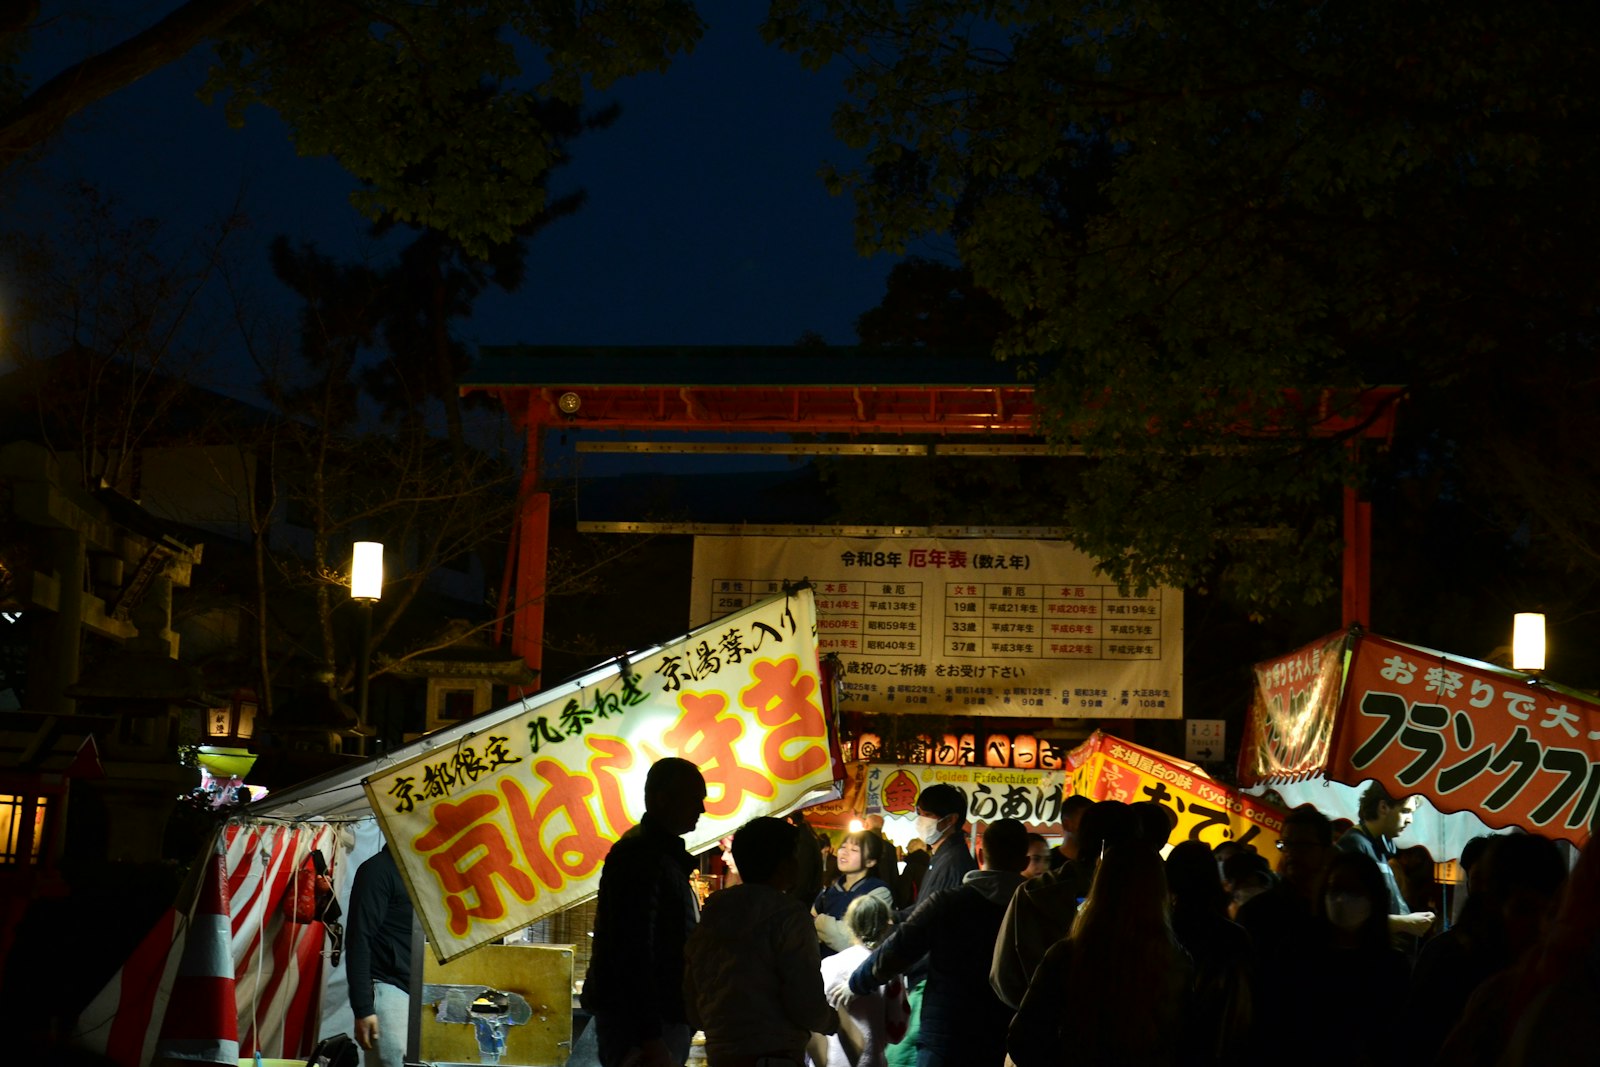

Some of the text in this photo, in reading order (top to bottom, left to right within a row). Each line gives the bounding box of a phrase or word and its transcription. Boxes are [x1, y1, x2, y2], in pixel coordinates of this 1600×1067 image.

[841, 549, 1030, 570] 令和8年 厄年表 (数え年)
[825, 584, 847, 593] 本厄
[883, 585, 905, 595] 後厄
[954, 586, 977, 595] 女性
[1002, 586, 1026, 597] 前厄
[1061, 588, 1085, 597] 本厄
[719, 598, 744, 608] 25歳
[869, 601, 917, 611] 平成13年生
[954, 602, 977, 612] 19歳
[989, 603, 1038, 613] 平成21年生
[1048, 604, 1097, 614] 平成20年生
[1106, 605, 1156, 615] 平成19年生
[868, 620, 917, 631] 昭和59年生
[952, 622, 977, 632] 33歳
[992, 623, 1035, 633] 平成7年生
[1051, 624, 1094, 634] 平成6年生
[1109, 625, 1153, 635] 平成5年生
[867, 640, 917, 651] 昭和40年生
[951, 642, 976, 652] 37歳
[991, 643, 1034, 653] 平成3年生
[1050, 644, 1093, 654] 平成2年生
[1108, 645, 1153, 655] 平成元年生
[934, 664, 1026, 678] をお受け下さい
[1022, 698, 1044, 706] 90歳
[1081, 699, 1104, 708] 99歳
[1139, 699, 1166, 708] 108歳
[1380, 655, 1600, 740] お祭りで大
[389, 607, 797, 813] 京都限定 九条ねぎ 京湯葉入り
[935, 771, 968, 782] Golden
[1109, 743, 1192, 790] 本場屋台の味
[1198, 784, 1243, 813] Kyoto
[1245, 808, 1284, 831] oden
[413, 654, 829, 938] 京はしまき
